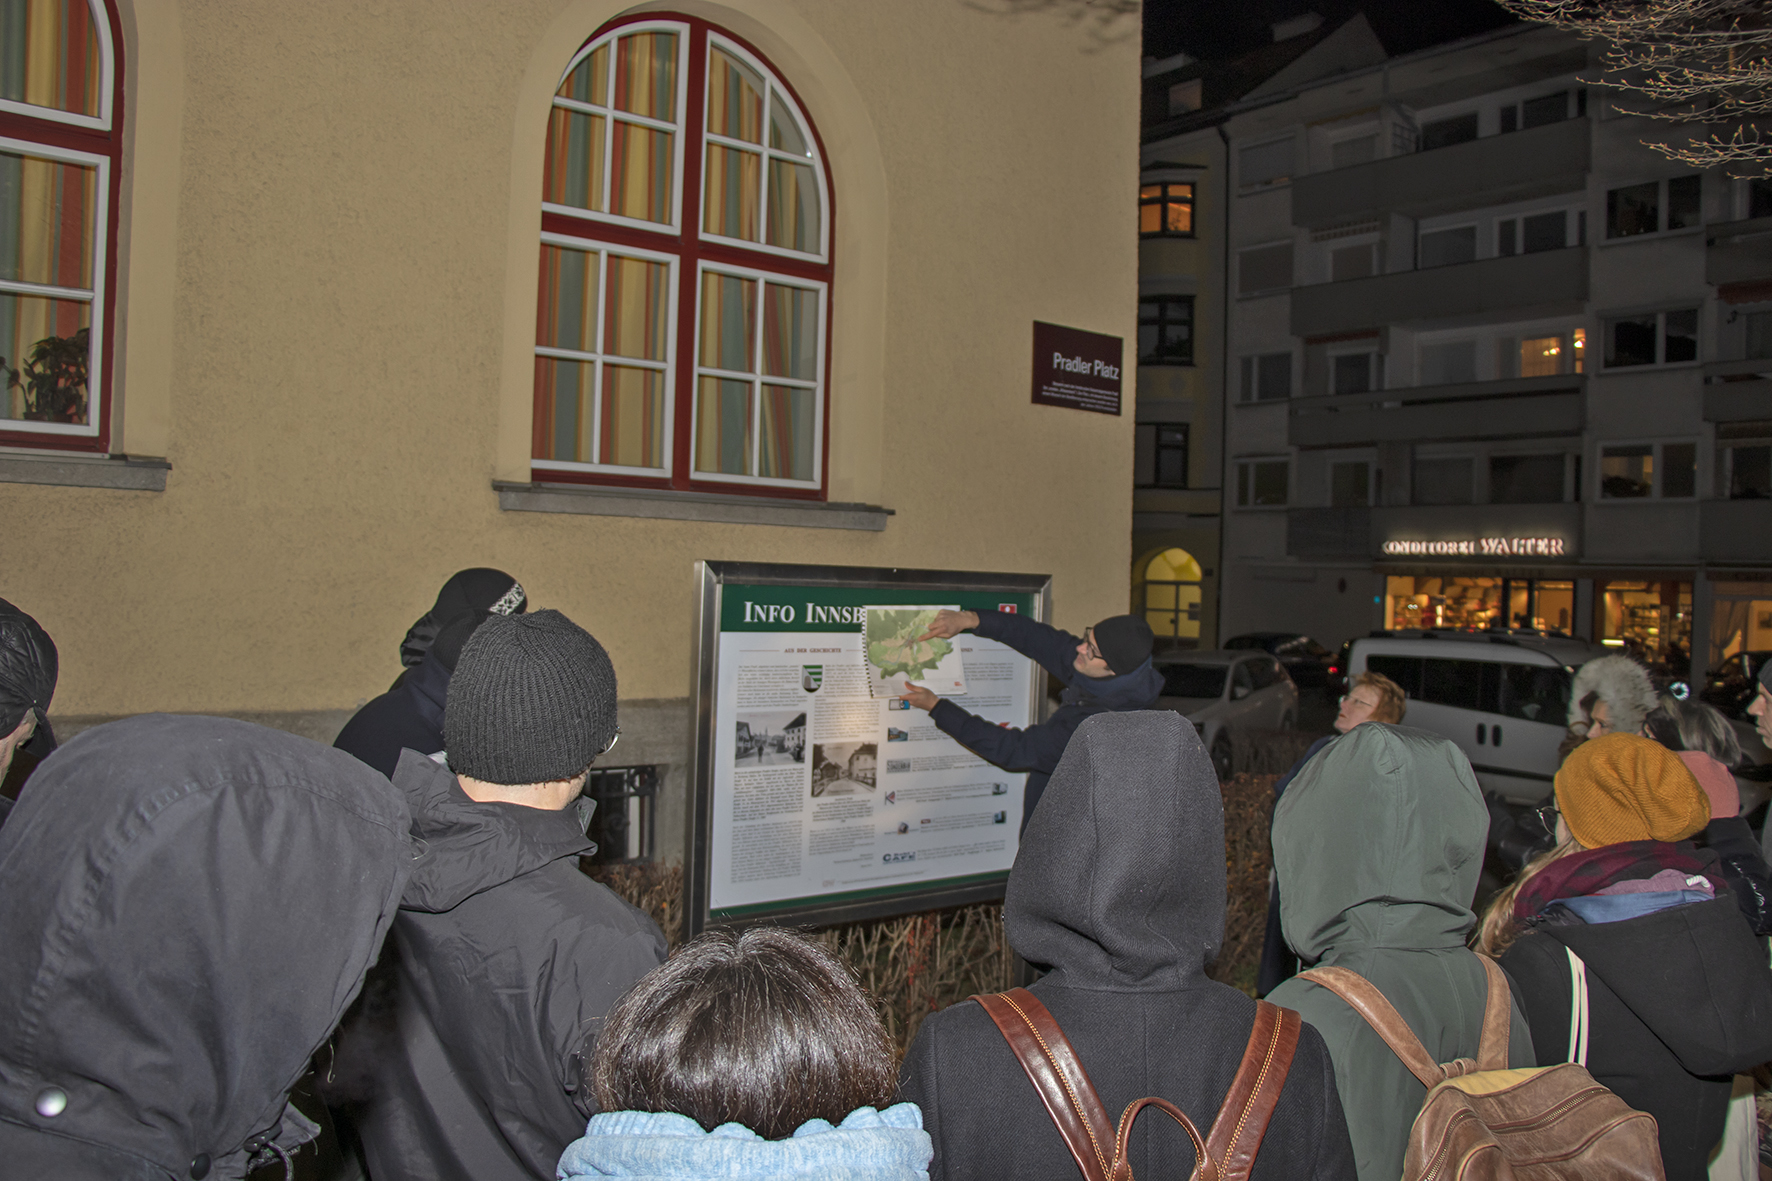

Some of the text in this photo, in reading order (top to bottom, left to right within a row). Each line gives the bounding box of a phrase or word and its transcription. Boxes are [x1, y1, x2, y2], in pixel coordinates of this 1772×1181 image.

[1053, 352, 1119, 380] Pradler Platz
[1479, 537, 1565, 556] WALTER
[743, 601, 864, 624] INFO INNSB
